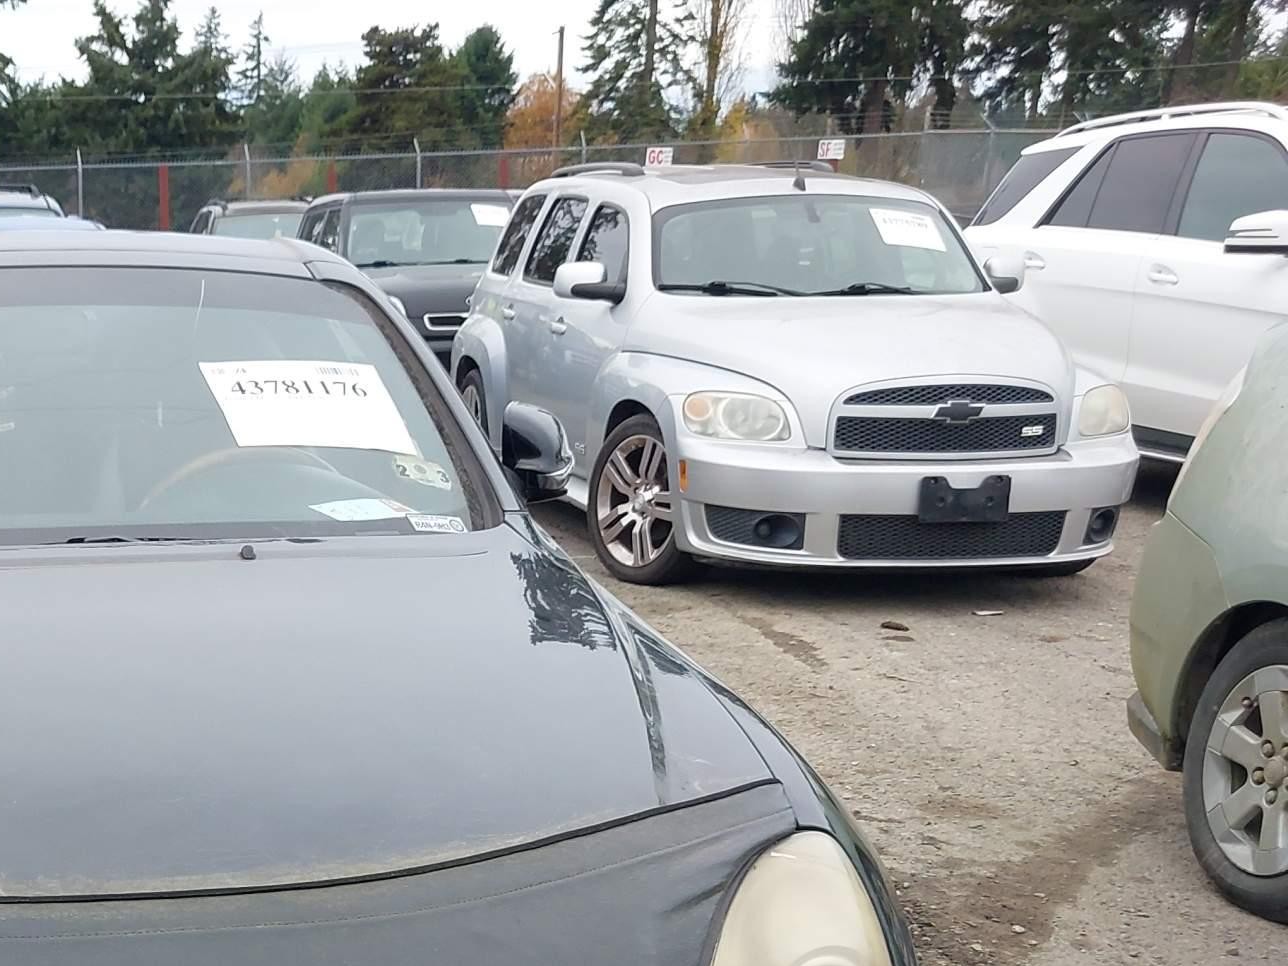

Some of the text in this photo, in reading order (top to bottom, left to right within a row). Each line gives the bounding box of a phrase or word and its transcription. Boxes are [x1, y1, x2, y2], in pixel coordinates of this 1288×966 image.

[648, 149, 664, 165] GC
[231, 379, 368, 398] 43781176
[1020, 425, 1044, 437] SS
